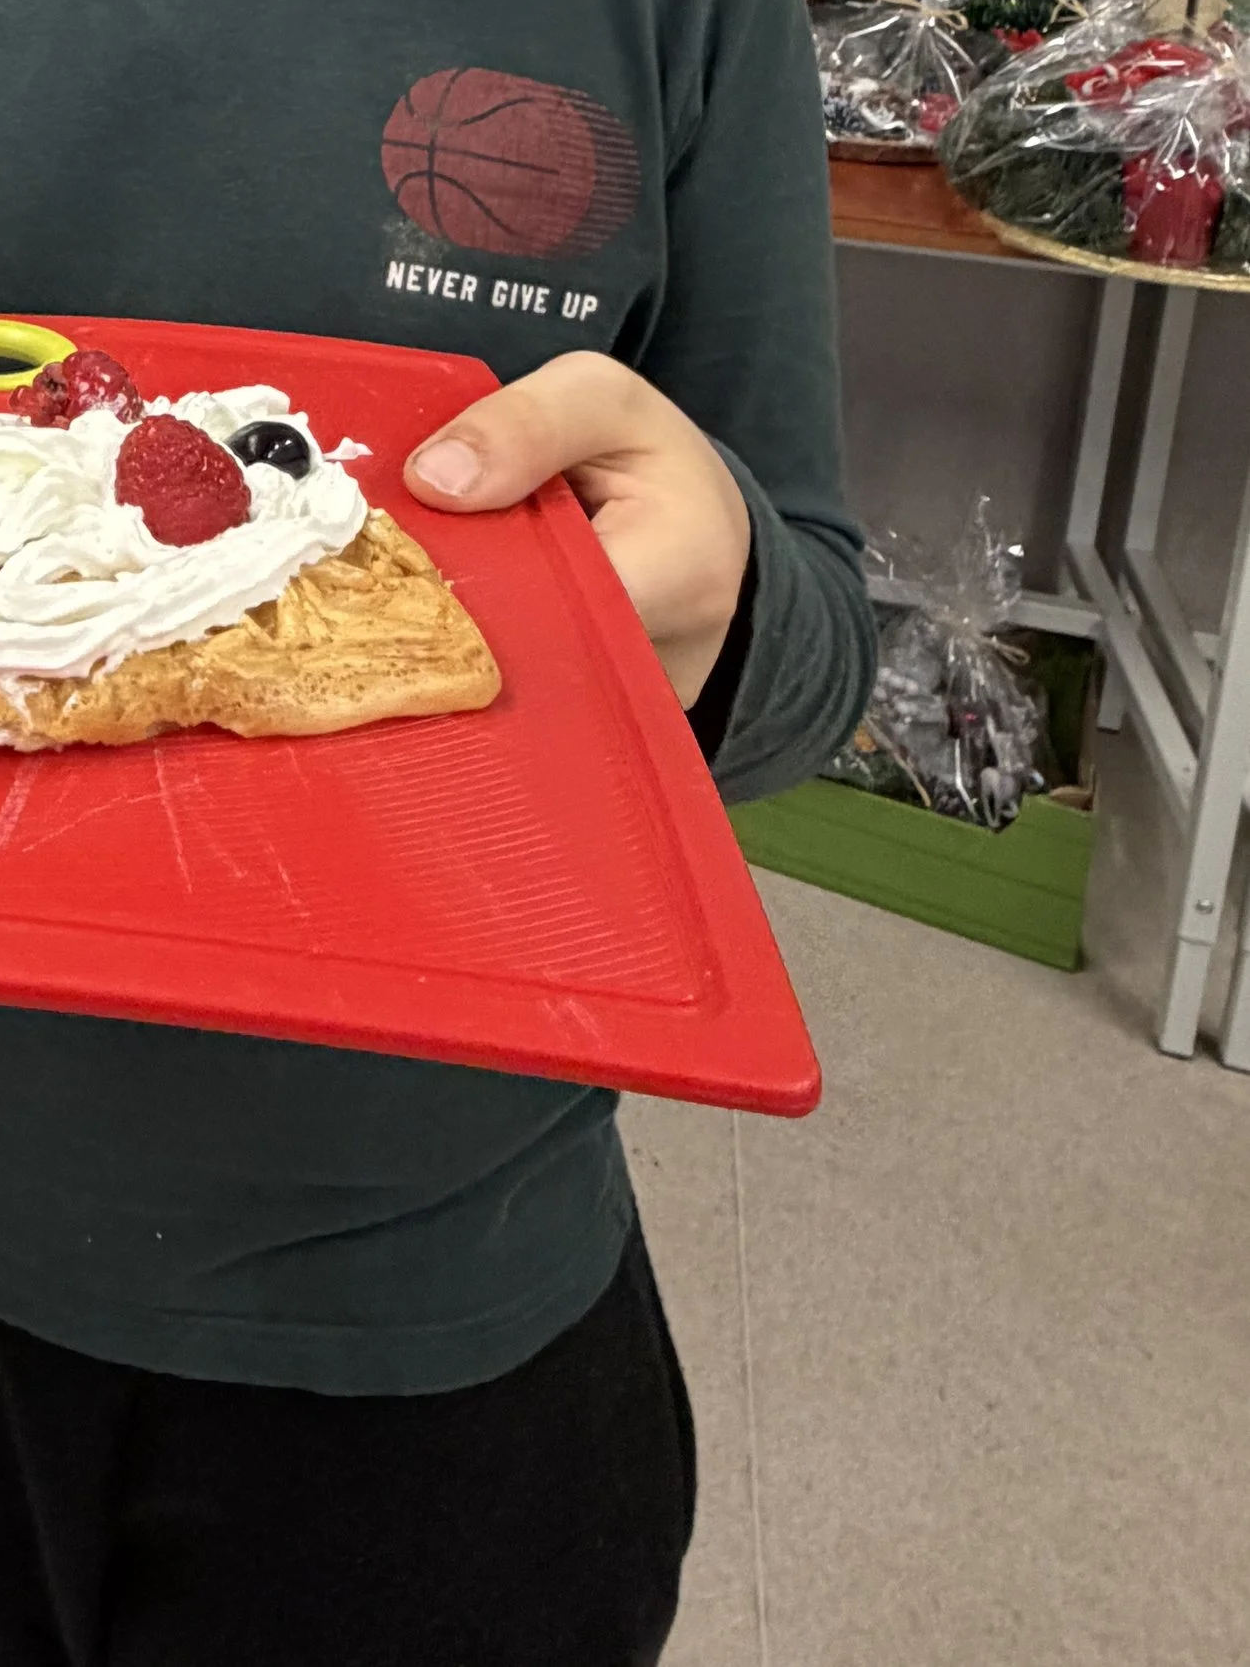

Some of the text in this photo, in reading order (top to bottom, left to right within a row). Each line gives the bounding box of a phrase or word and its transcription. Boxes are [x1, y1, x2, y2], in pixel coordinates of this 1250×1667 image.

[386, 260, 598, 321] NEVER GIVE UP
